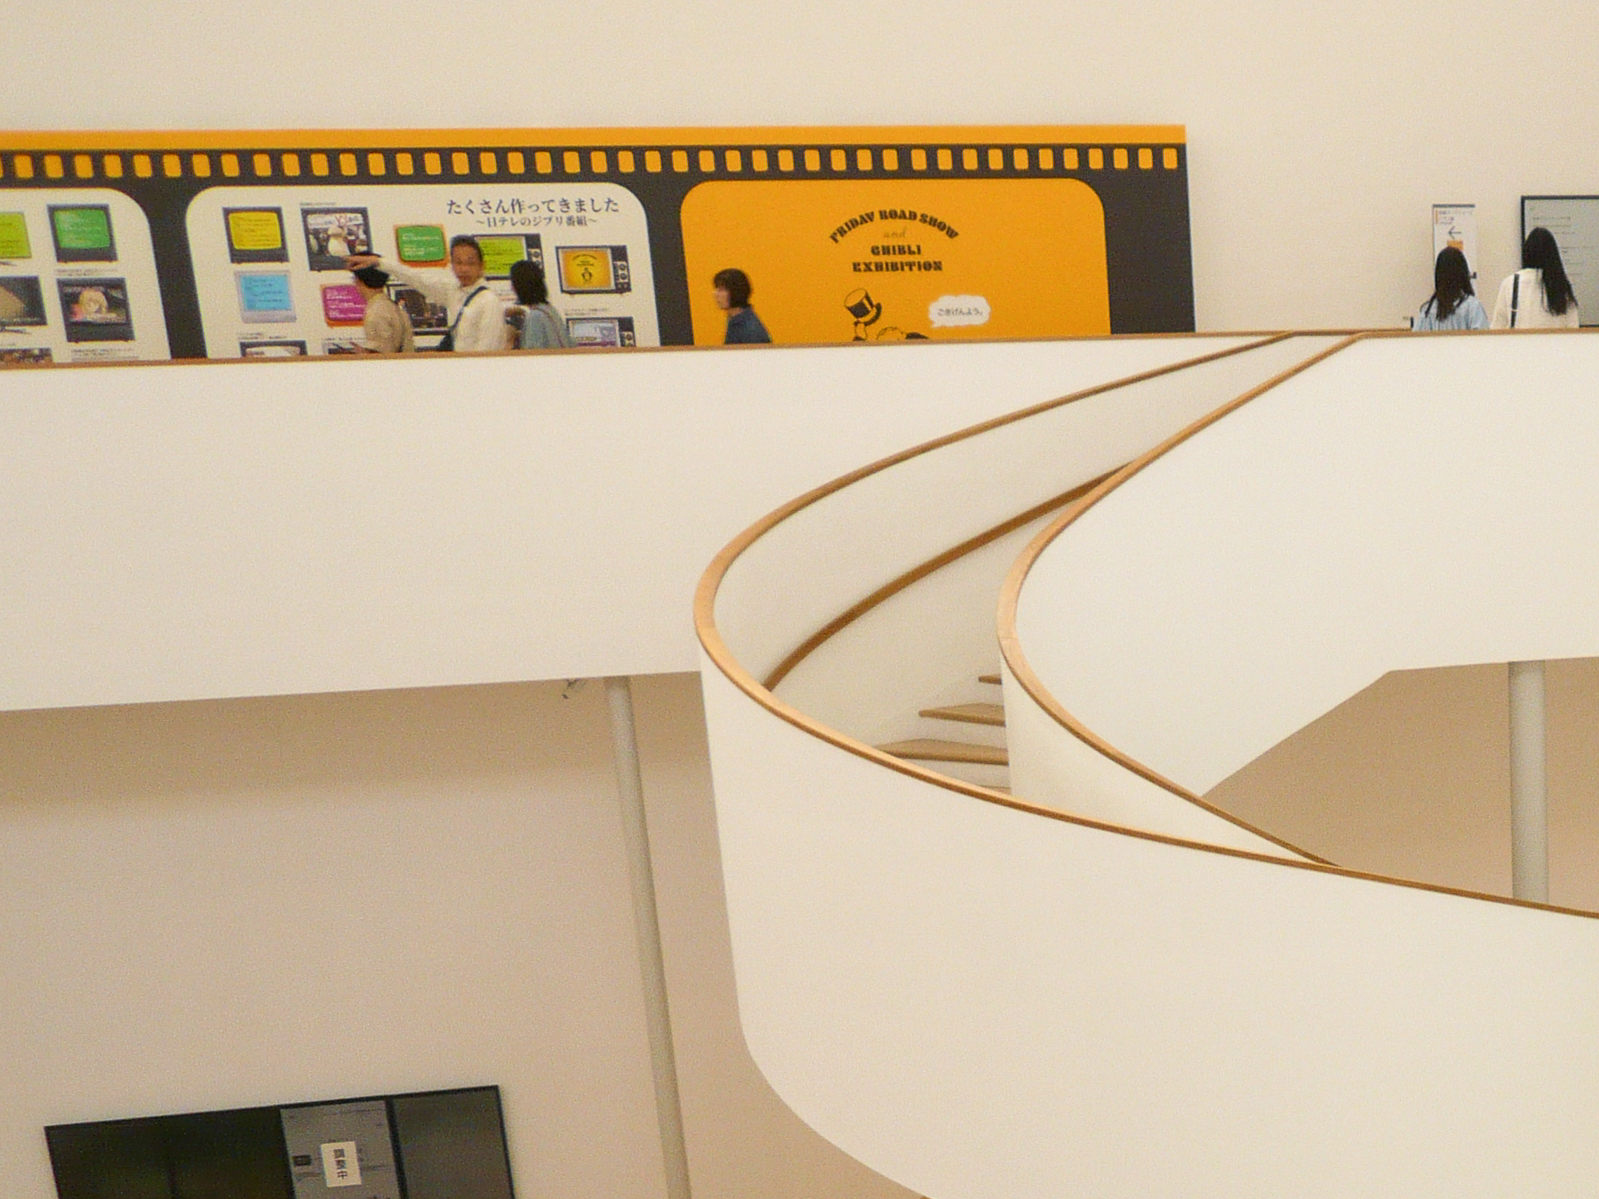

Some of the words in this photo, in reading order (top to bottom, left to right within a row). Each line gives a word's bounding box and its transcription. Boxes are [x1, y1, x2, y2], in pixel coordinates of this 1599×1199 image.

[446, 197, 620, 215] たくさん作ってきました
[829, 211, 875, 244] FRIDAY
[878, 208, 918, 221] ROAD
[918, 212, 960, 240] SHOW
[870, 244, 922, 257] GHIBLI
[852, 260, 943, 273] EXHIBITION
